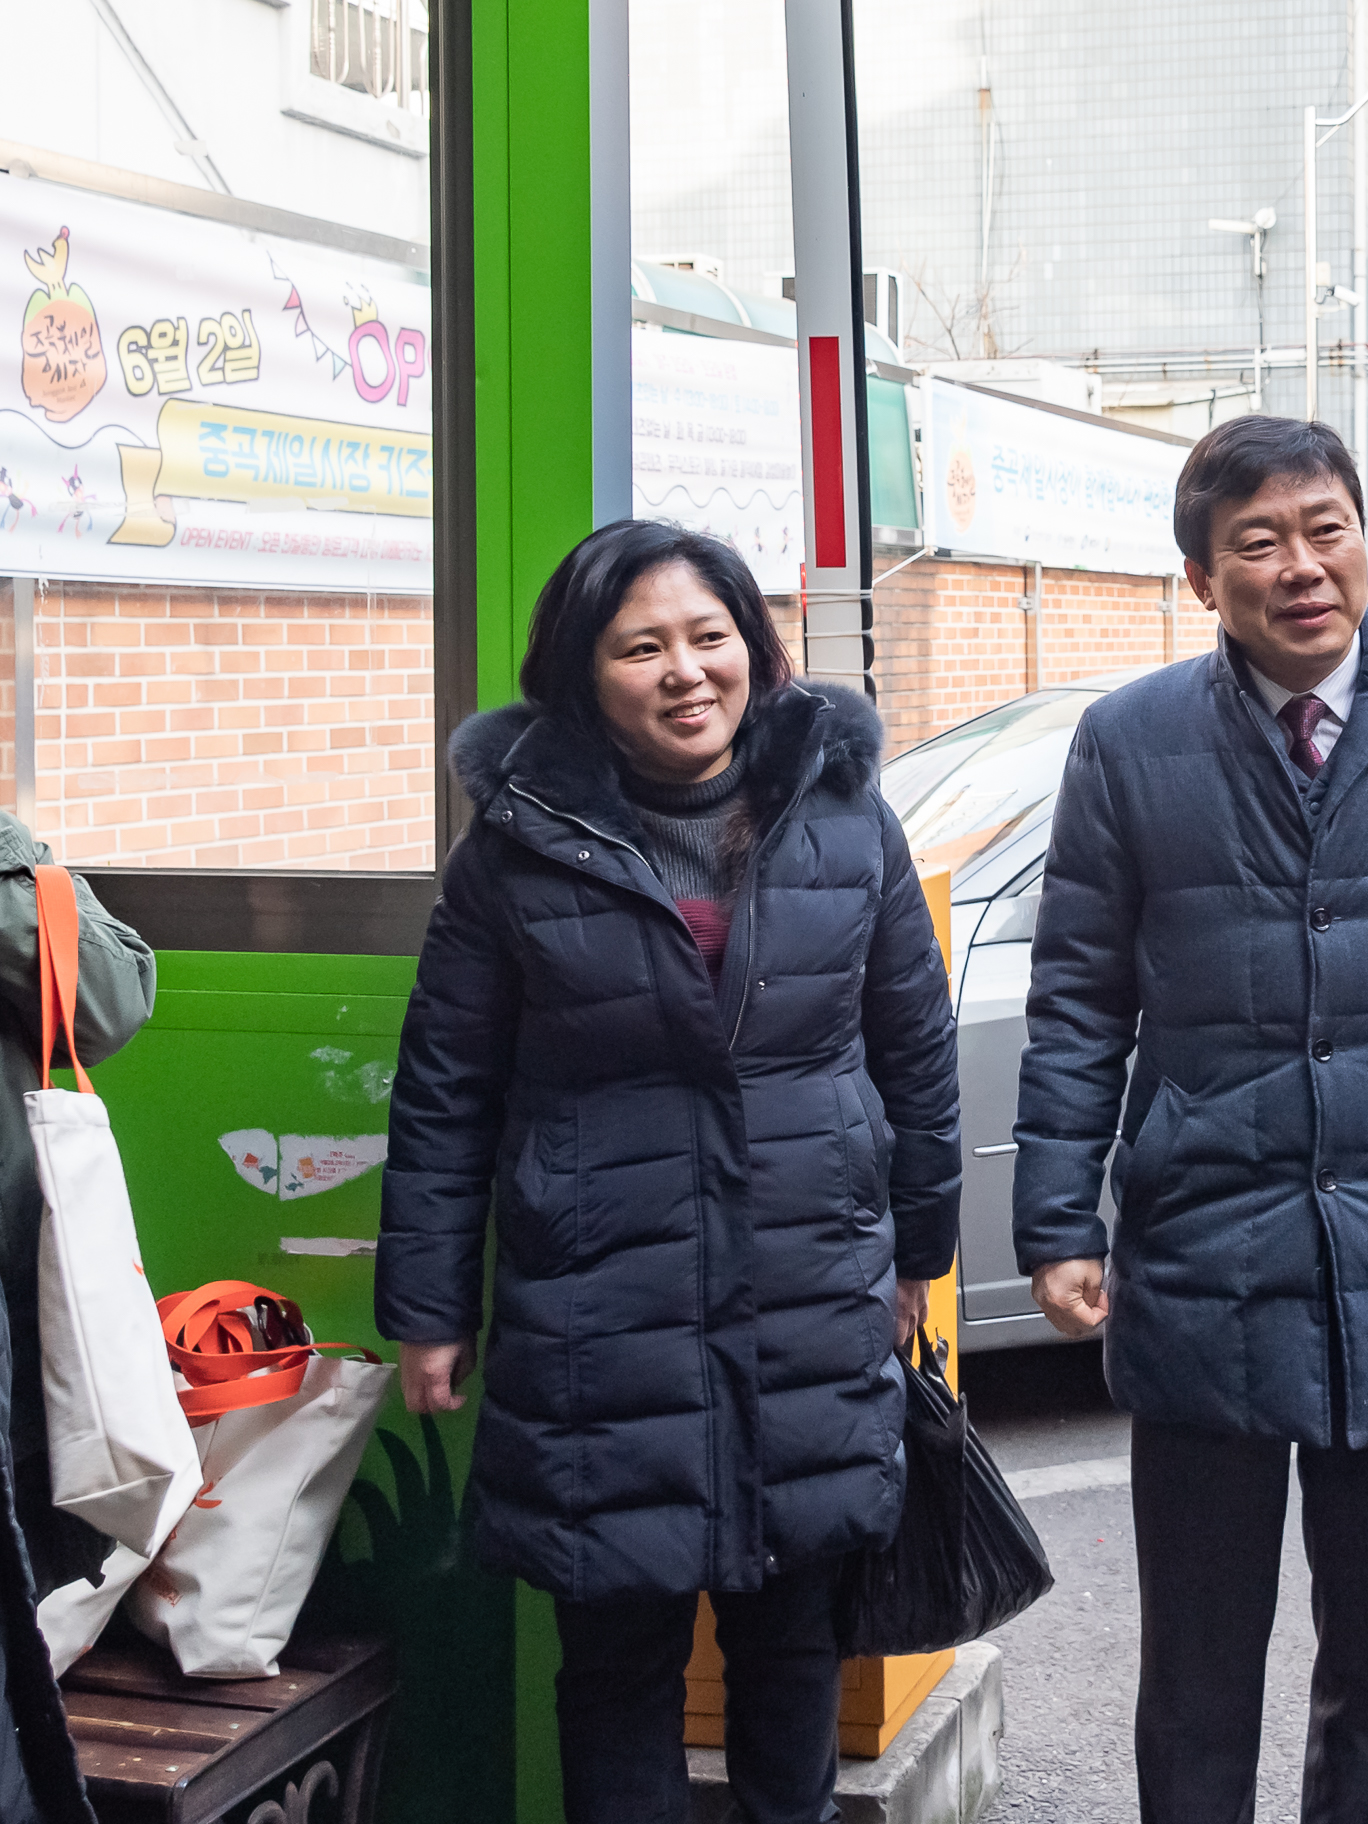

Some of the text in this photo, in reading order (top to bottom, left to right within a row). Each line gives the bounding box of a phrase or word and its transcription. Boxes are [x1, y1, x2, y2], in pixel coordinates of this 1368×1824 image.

[117, 308, 261, 397] 6월 2일
[348, 320, 431, 406] OP
[198, 420, 431, 498] 중곡제일시장 키즈
[990, 444, 1081, 508] 중곡제일시장이
[180, 527, 214, 549] OPEN
[214, 529, 254, 552] EVENT
